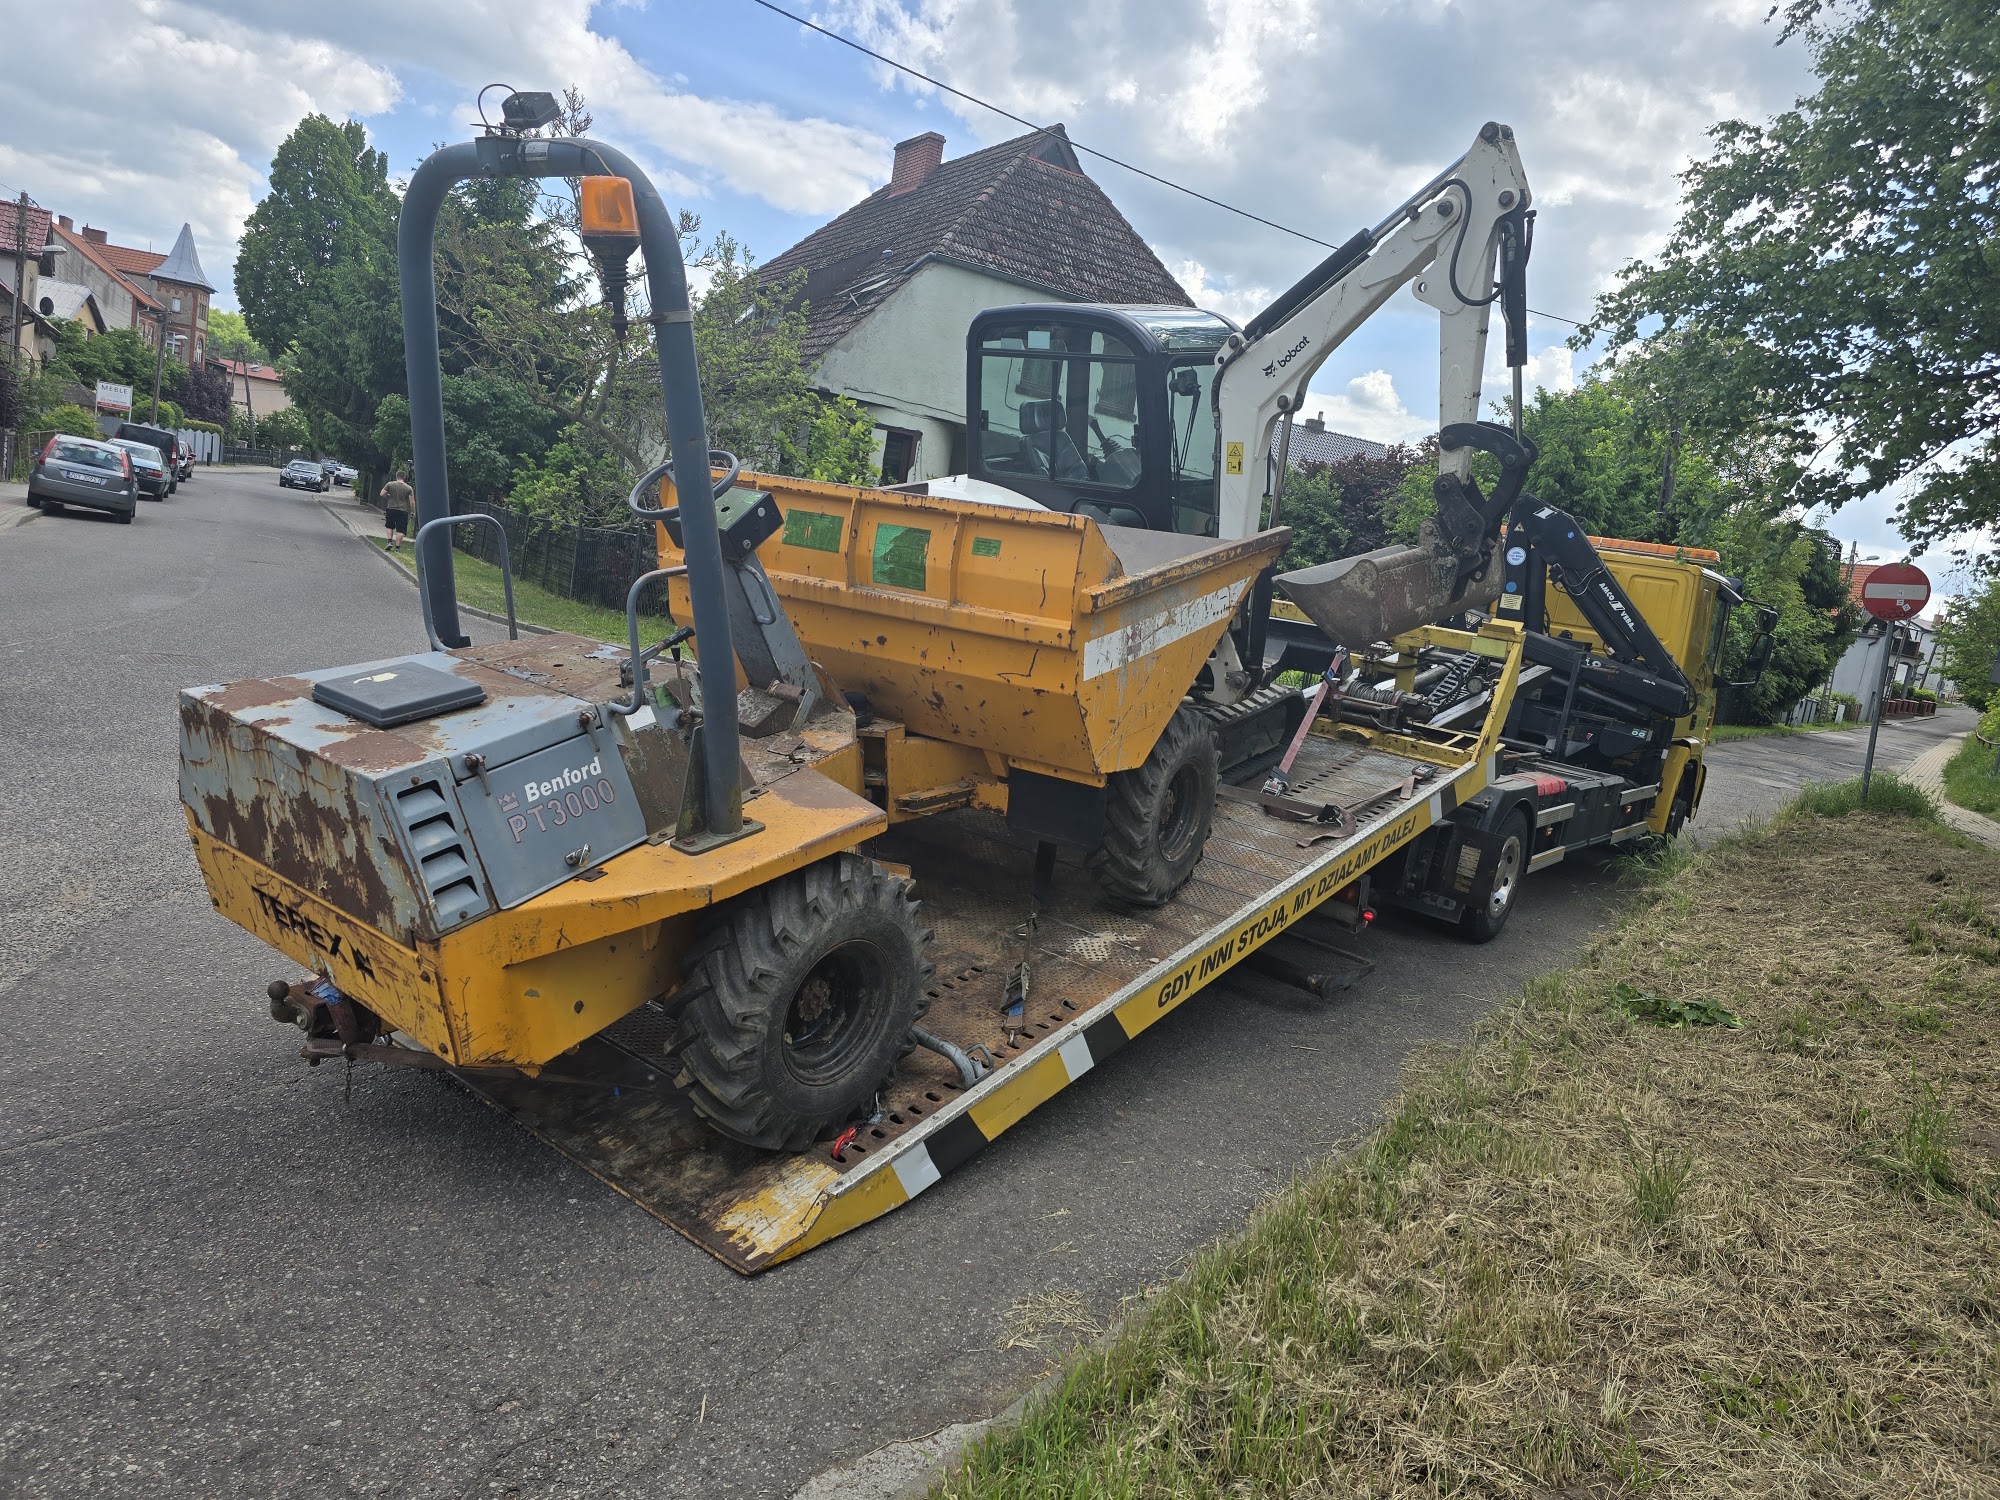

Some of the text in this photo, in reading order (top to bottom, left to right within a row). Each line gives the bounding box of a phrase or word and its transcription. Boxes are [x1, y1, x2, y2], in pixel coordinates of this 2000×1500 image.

[1277, 335, 1310, 368] bobcat
[101, 384, 128, 394] MEBLE
[1598, 582, 1635, 630] AMCO VEBA
[524, 755, 602, 803] Benford
[507, 778, 615, 844] PT3000
[251, 885, 350, 966] TEREX
[1157, 815, 1417, 1009] GDY INNI STOJĄ, MY DZIAŁAMY DALEJ
